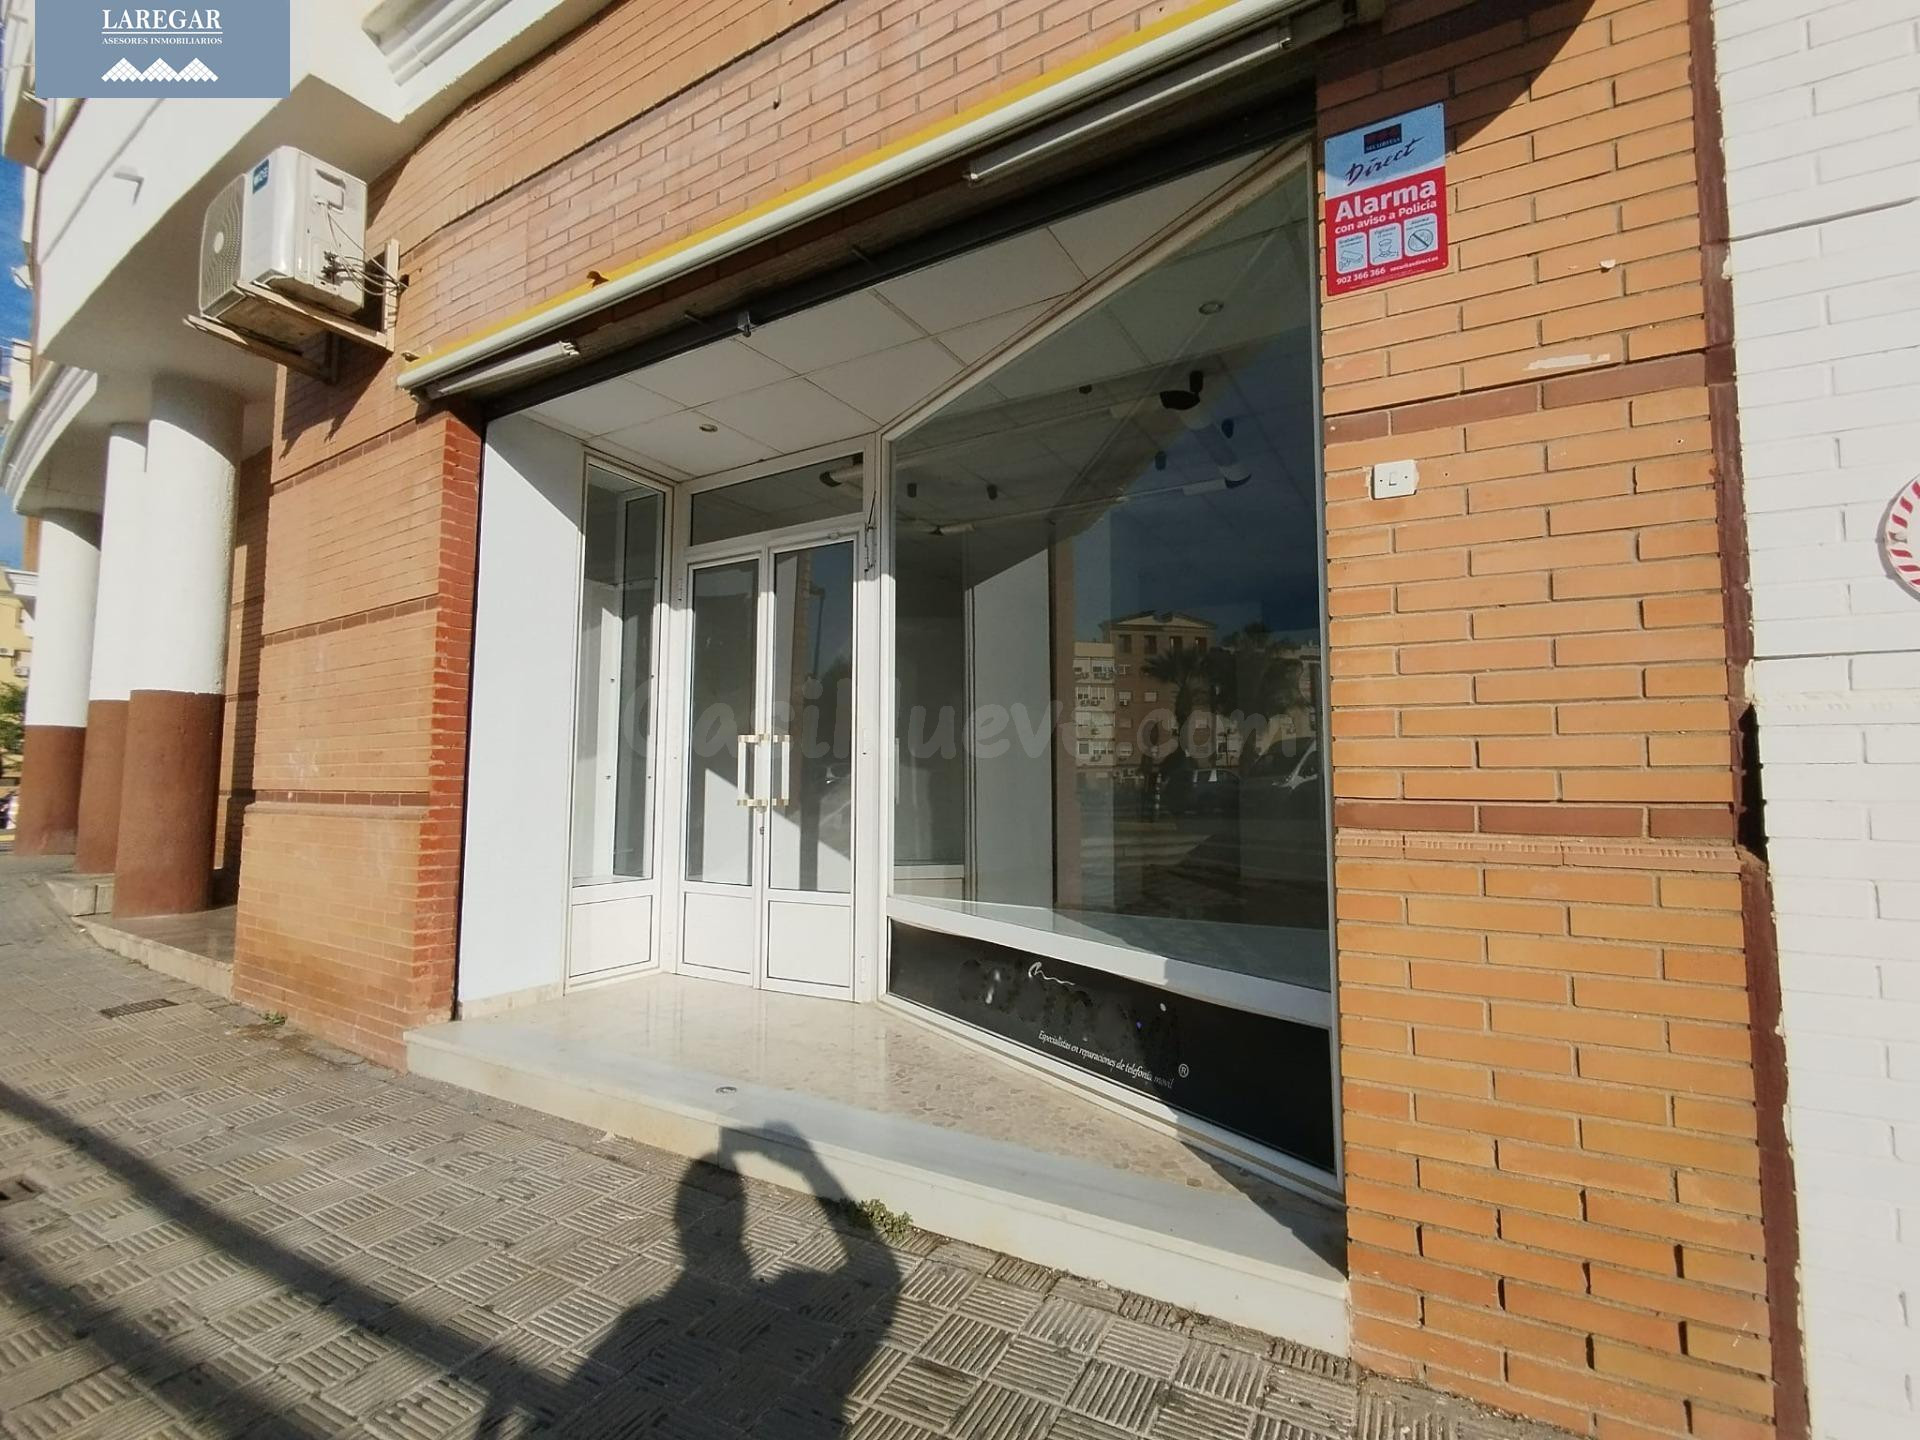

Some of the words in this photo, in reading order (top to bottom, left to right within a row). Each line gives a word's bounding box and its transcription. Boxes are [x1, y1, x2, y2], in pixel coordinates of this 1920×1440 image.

[1345, 136, 1424, 186] Direct
[1335, 180, 1437, 222] Alarma
[1335, 222, 1355, 234] con
[1357, 214, 1386, 229] aviso
[1389, 212, 1396, 220] a
[1399, 200, 1437, 217] Policía
[1336, 275, 1352, 285] 902
[1116, 1058, 1126, 1070] de
